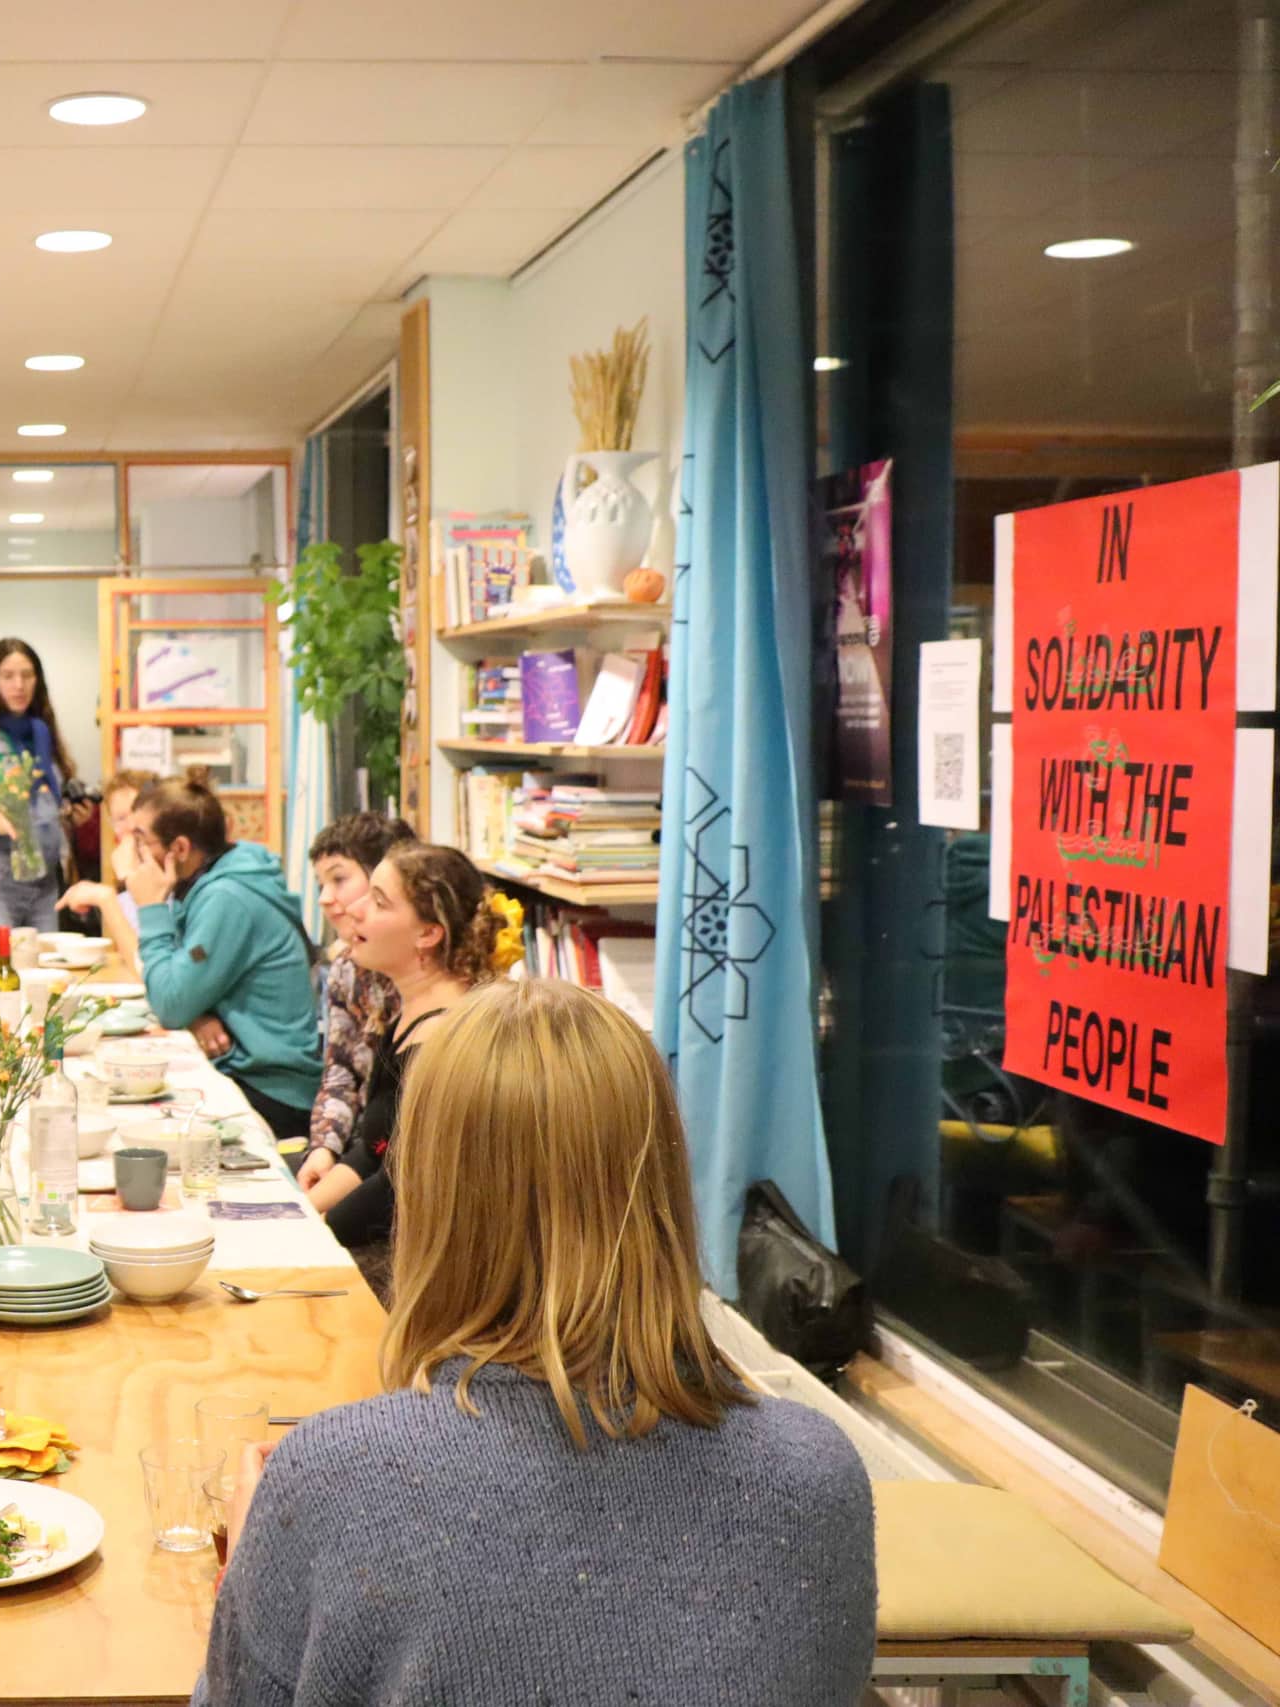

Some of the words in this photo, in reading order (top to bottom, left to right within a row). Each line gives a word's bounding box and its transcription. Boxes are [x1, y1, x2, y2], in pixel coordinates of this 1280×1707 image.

[1096, 502, 1134, 583] IN
[1024, 626, 1223, 712] SOLIDARITY
[1039, 757, 1113, 838] WITH
[1123, 762, 1194, 846] THE
[1012, 874, 1222, 988] PALESTINIAN
[1043, 1000, 1172, 1110] PEOPLE
